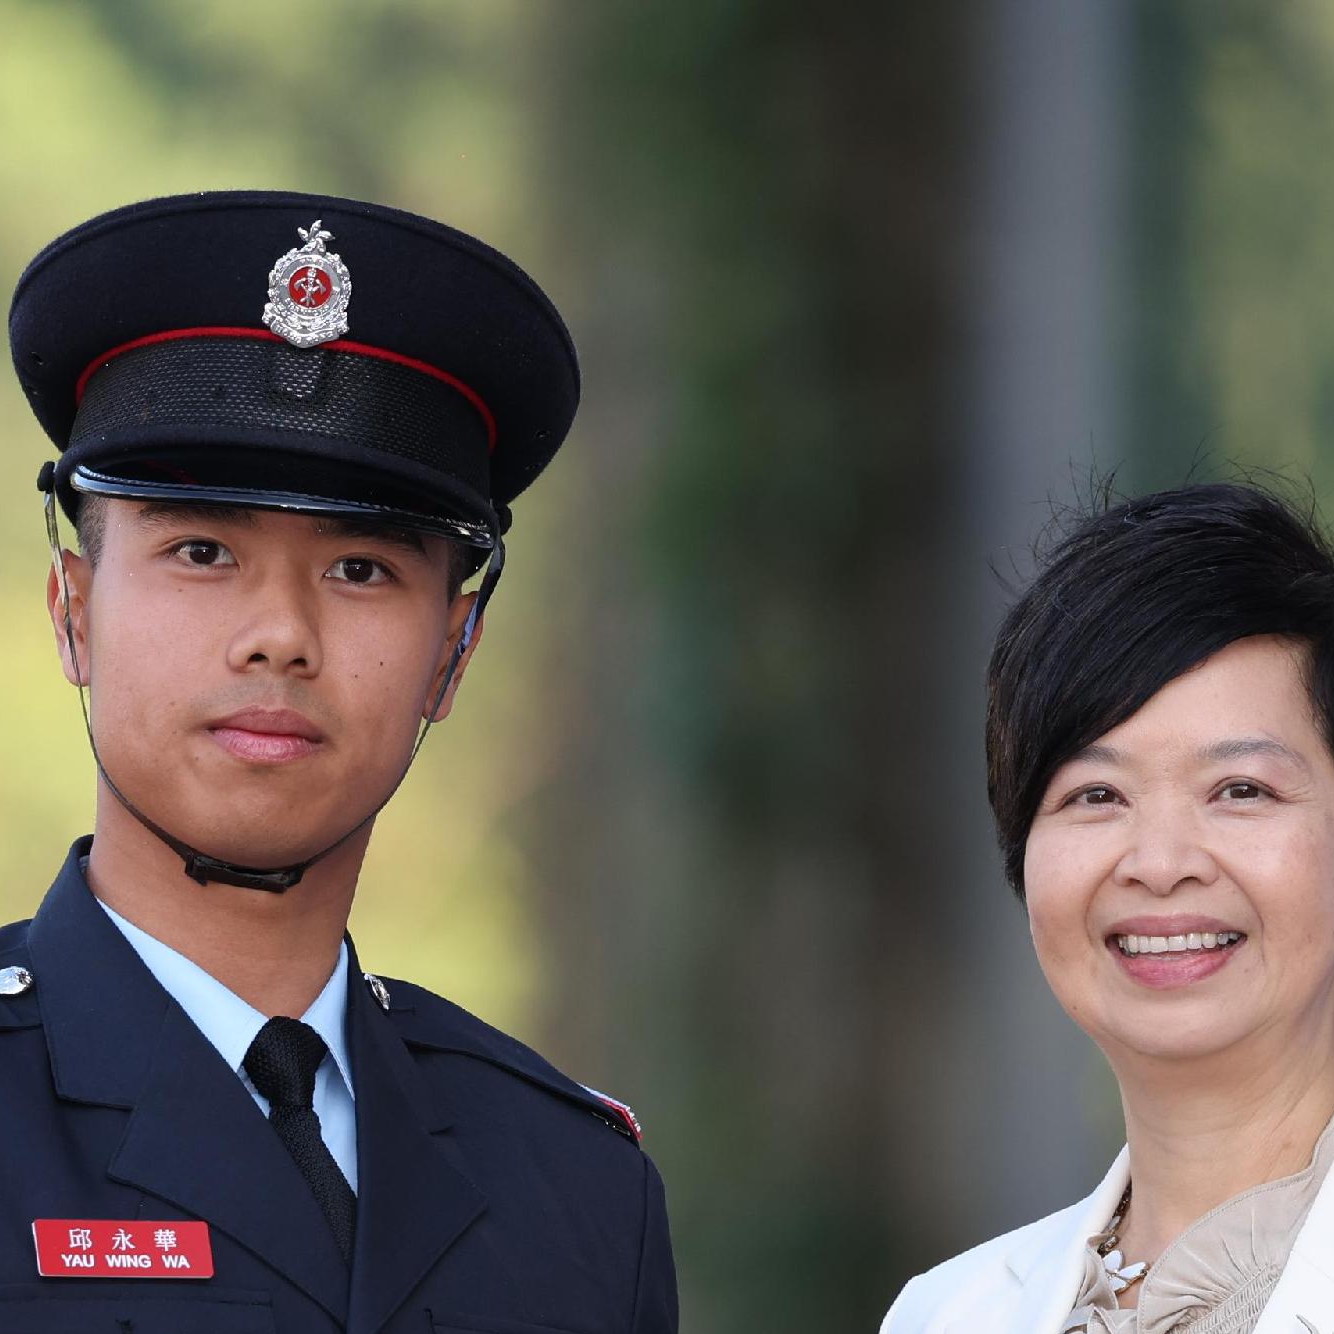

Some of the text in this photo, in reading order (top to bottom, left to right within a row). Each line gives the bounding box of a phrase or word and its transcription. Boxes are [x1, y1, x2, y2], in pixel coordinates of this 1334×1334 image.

[61, 1254, 191, 1269] YAU WING WA
